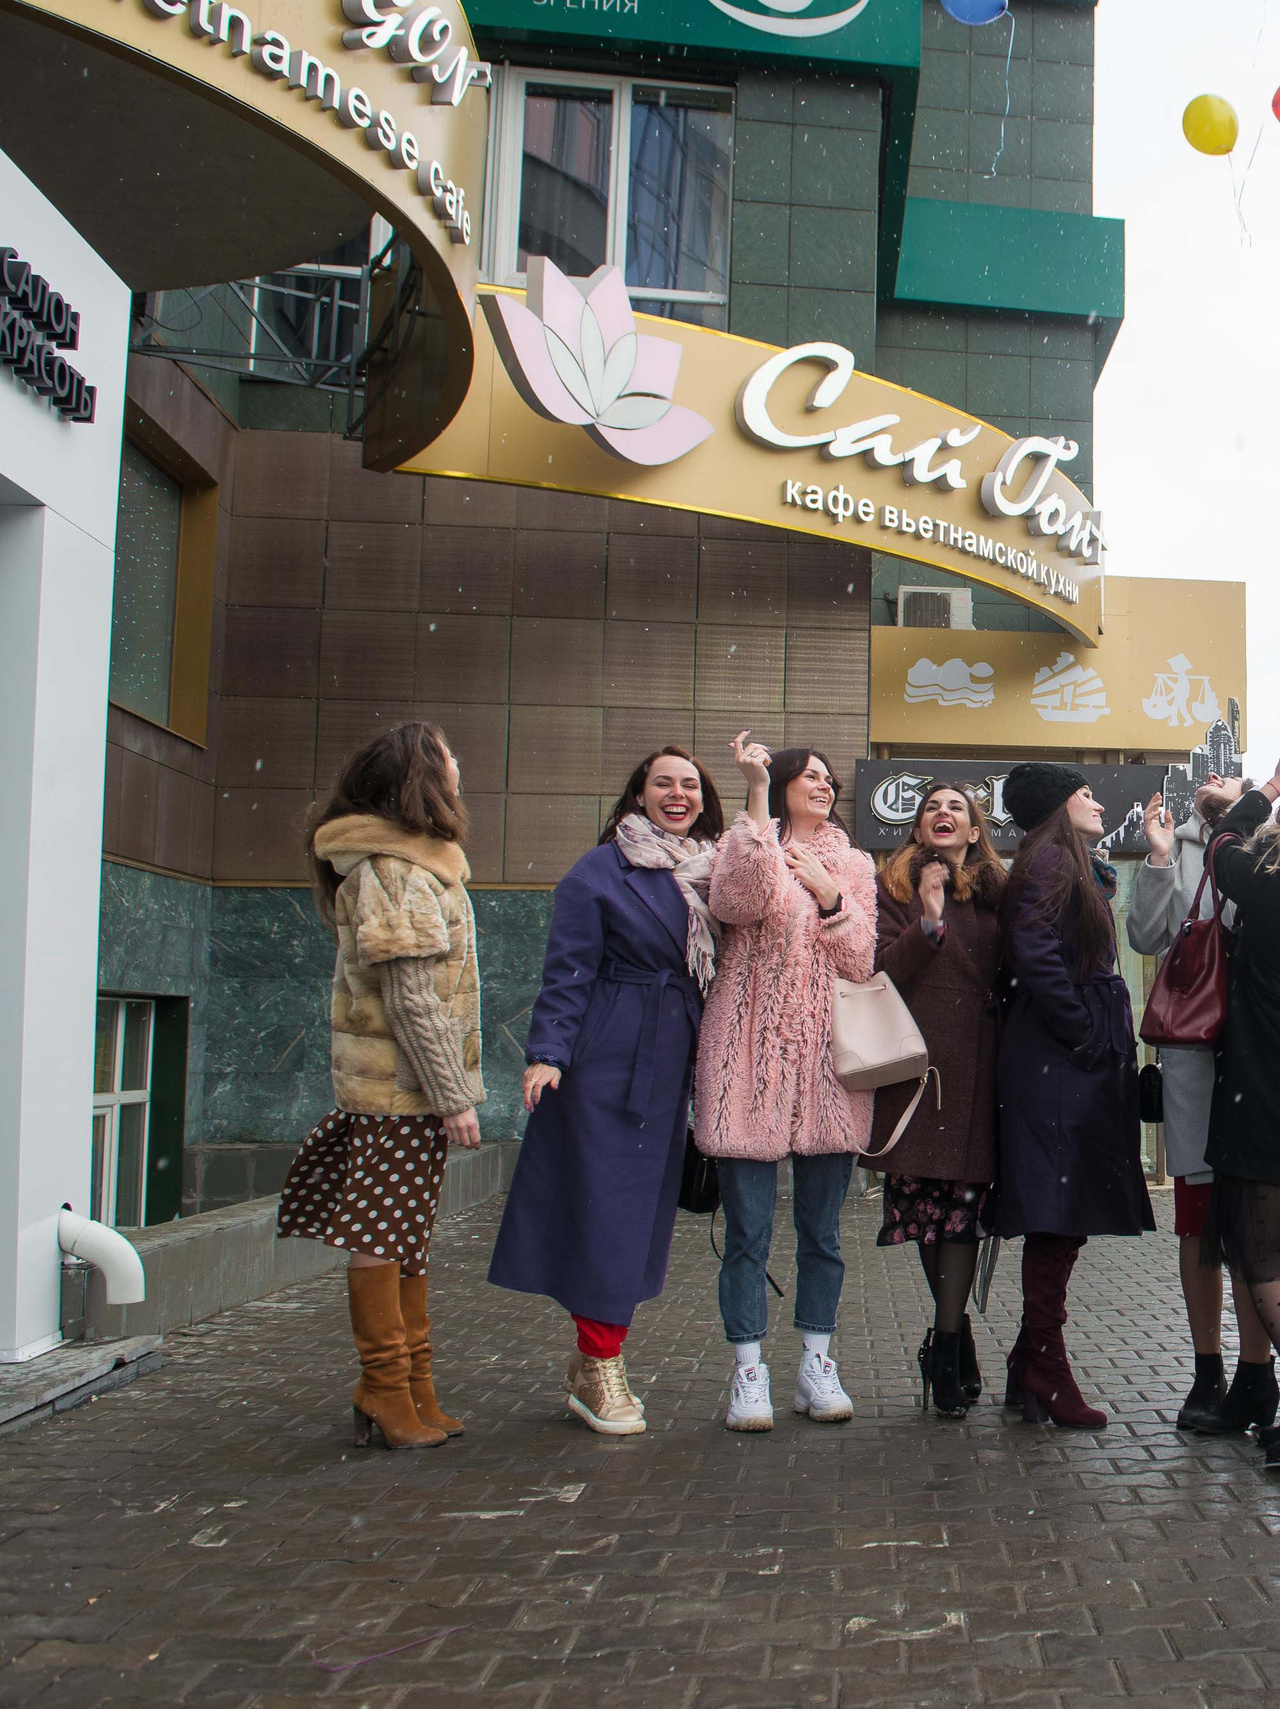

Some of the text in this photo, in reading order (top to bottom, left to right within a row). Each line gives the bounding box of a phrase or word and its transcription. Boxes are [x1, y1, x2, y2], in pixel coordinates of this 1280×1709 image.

[429, 159, 472, 245] cafe
[0, 246, 81, 351] САЛОН
[0, 311, 97, 423] КРАСОТЫ
[740, 341, 982, 490] Сай
[785, 477, 1080, 605] кафе вьетнамской кухни
